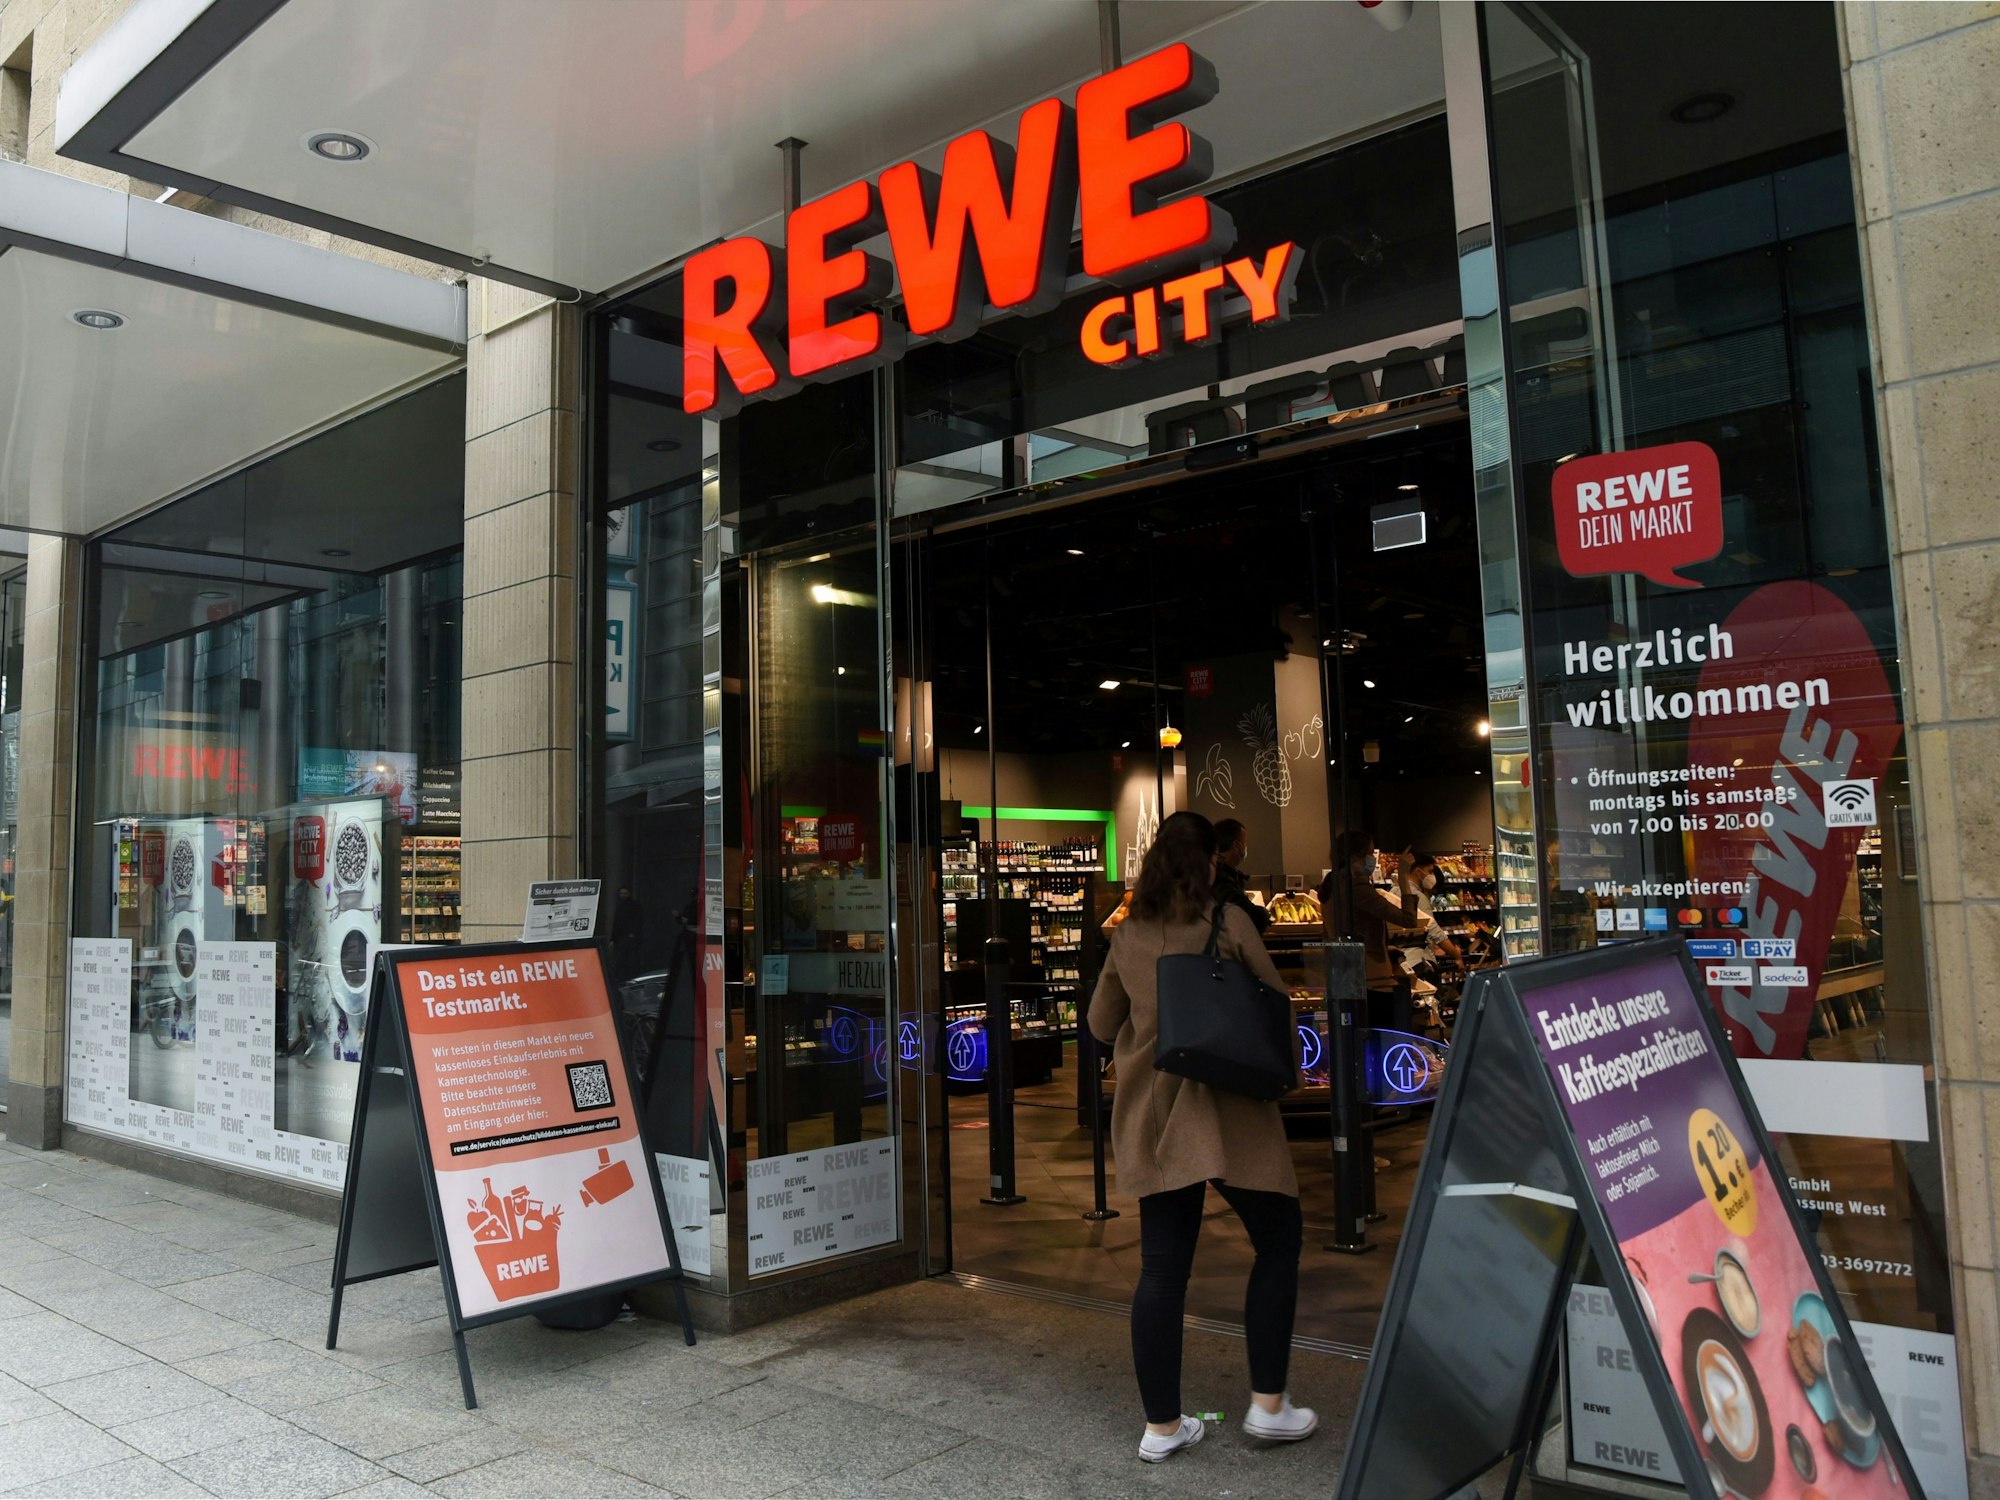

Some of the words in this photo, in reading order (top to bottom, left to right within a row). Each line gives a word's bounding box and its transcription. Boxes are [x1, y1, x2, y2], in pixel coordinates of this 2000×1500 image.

[683, 41, 1212, 414] REWE
[1080, 240, 1296, 364] CITY
[1577, 465, 1693, 514] REWE
[1579, 516, 1624, 548] DEIN
[1630, 501, 1694, 542] MARKT
[1564, 623, 1734, 676] Herzlich
[1566, 677, 1830, 728] willkommen
[134, 744, 249, 780] REWE
[1588, 764, 1736, 788] Öffnungszeiten:
[422, 796, 450, 804] Cappuccino
[1590, 792, 1666, 812] montags
[1672, 790, 1700, 806] bis
[1706, 785, 1796, 805] samstags
[1591, 820, 1622, 835] von
[1629, 817, 1673, 834] 7.00
[1680, 815, 1708, 831] bis
[1714, 812, 1774, 830] 20.00
[1830, 813, 1852, 824] GRATIS
[1853, 812, 1872, 822] WLAN
[298, 825, 320, 838] REWE
[824, 823, 854, 836] REWE
[300, 840, 318, 854] CITY
[1594, 882, 1624, 897] Wir
[1632, 878, 1751, 898] akzeptieren:
[260, 950, 272, 959] REWE
[1764, 946, 1792, 957] PAY
[84, 962, 98, 974] REWE
[212, 969, 230, 982] REWE
[418, 970, 456, 992] Das
[460, 968, 486, 988] ist
[490, 965, 518, 985] ein
[521, 959, 578, 982] REWE
[1764, 974, 1805, 982] sodexo
[218, 994, 234, 1006] REWE
[422, 991, 528, 1018] Testmarkt.
[224, 1018, 248, 1034] REWE
[1538, 996, 1621, 1050] Entdecke
[1618, 990, 1670, 1027] unsere
[432, 1047, 449, 1058] Wir
[451, 1044, 480, 1055] testen
[481, 1042, 490, 1051] in
[494, 1039, 525, 1050] diesem
[528, 1036, 552, 1046] Markt
[554, 1034, 568, 1043] ein
[570, 1031, 594, 1041] neues
[250, 1054, 272, 1069] REWE
[435, 1058, 492, 1072] kassenloses
[494, 1048, 567, 1064] Einkaufserlebnis
[570, 1046, 584, 1056] mit
[1558, 1027, 1708, 1104] Kaffeespezialitäten
[216, 1061, 240, 1079] REWE
[438, 1068, 530, 1088] Kameratechnologie.
[441, 1091, 464, 1102] Bitte
[466, 1087, 503, 1100] beachte
[506, 1082, 536, 1093] unsere
[197, 1102, 216, 1116] REWE
[444, 1096, 542, 1118] Datenschutzhinweise
[128, 1113, 148, 1130] REWE
[174, 1111, 195, 1128] REWE
[221, 1116, 244, 1134] REWE
[447, 1124, 462, 1132] am
[464, 1117, 502, 1131] Eingang
[504, 1112, 524, 1122] oder
[528, 1110, 548, 1120] hier:
[1587, 1134, 1608, 1156] Auch
[1606, 1120, 1642, 1150] erhältlich
[1640, 1114, 1653, 1133] mit
[256, 1150, 271, 1162] REWE
[274, 1145, 300, 1165] REWE
[312, 1148, 332, 1164] REWE
[824, 1148, 868, 1172] REWE
[1595, 1147, 1641, 1179] laktosefreier
[1638, 1136, 1660, 1157] Milch
[322, 1168, 339, 1182] REWE
[659, 1161, 689, 1182] EWE
[784, 1176, 807, 1188] REWE
[1606, 1182, 1624, 1202] oder
[1622, 1164, 1660, 1194] Sojamilch.
[1788, 1177, 1830, 1192] GmbH
[757, 1191, 793, 1210] REWE
[818, 1172, 890, 1213] REWE
[782, 1208, 805, 1220] REWE
[1848, 1200, 1886, 1216] West
[793, 1222, 834, 1246] REWE
[854, 1218, 890, 1240] REWE
[497, 1254, 550, 1280] REWE
[755, 1252, 785, 1269] REWE
[1909, 1352, 1945, 1366] REWE
[1584, 1402, 1611, 1414] REWE
[1594, 1441, 1660, 1471] REWE
